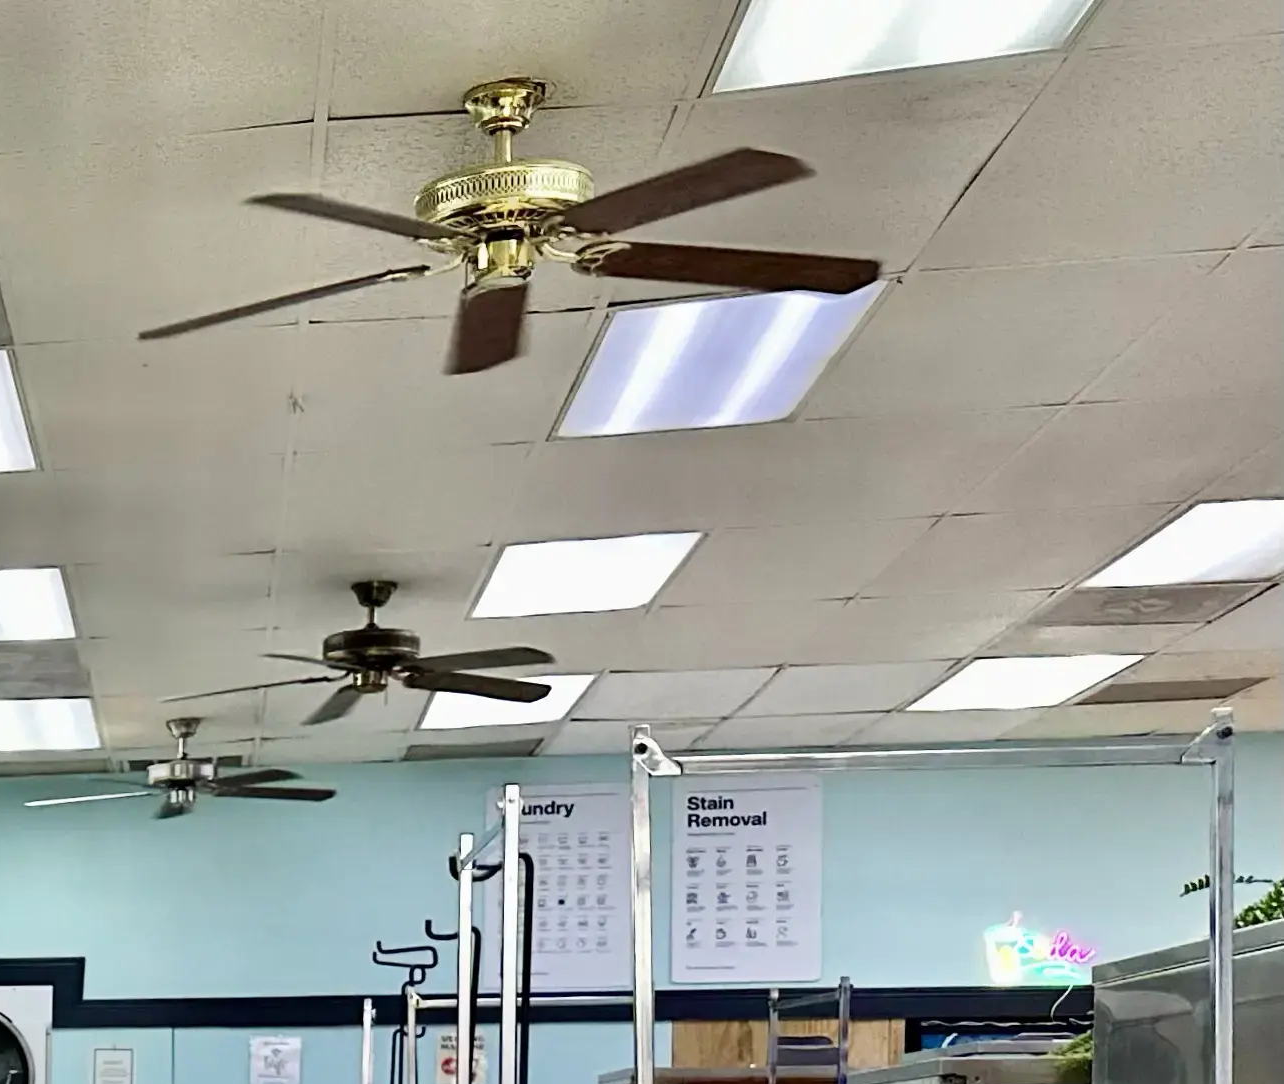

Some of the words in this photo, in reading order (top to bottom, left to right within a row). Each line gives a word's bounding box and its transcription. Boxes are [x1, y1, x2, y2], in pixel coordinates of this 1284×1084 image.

[521, 800, 575, 818] undry
[687, 795, 734, 811] Stain
[687, 810, 767, 828] Removal
